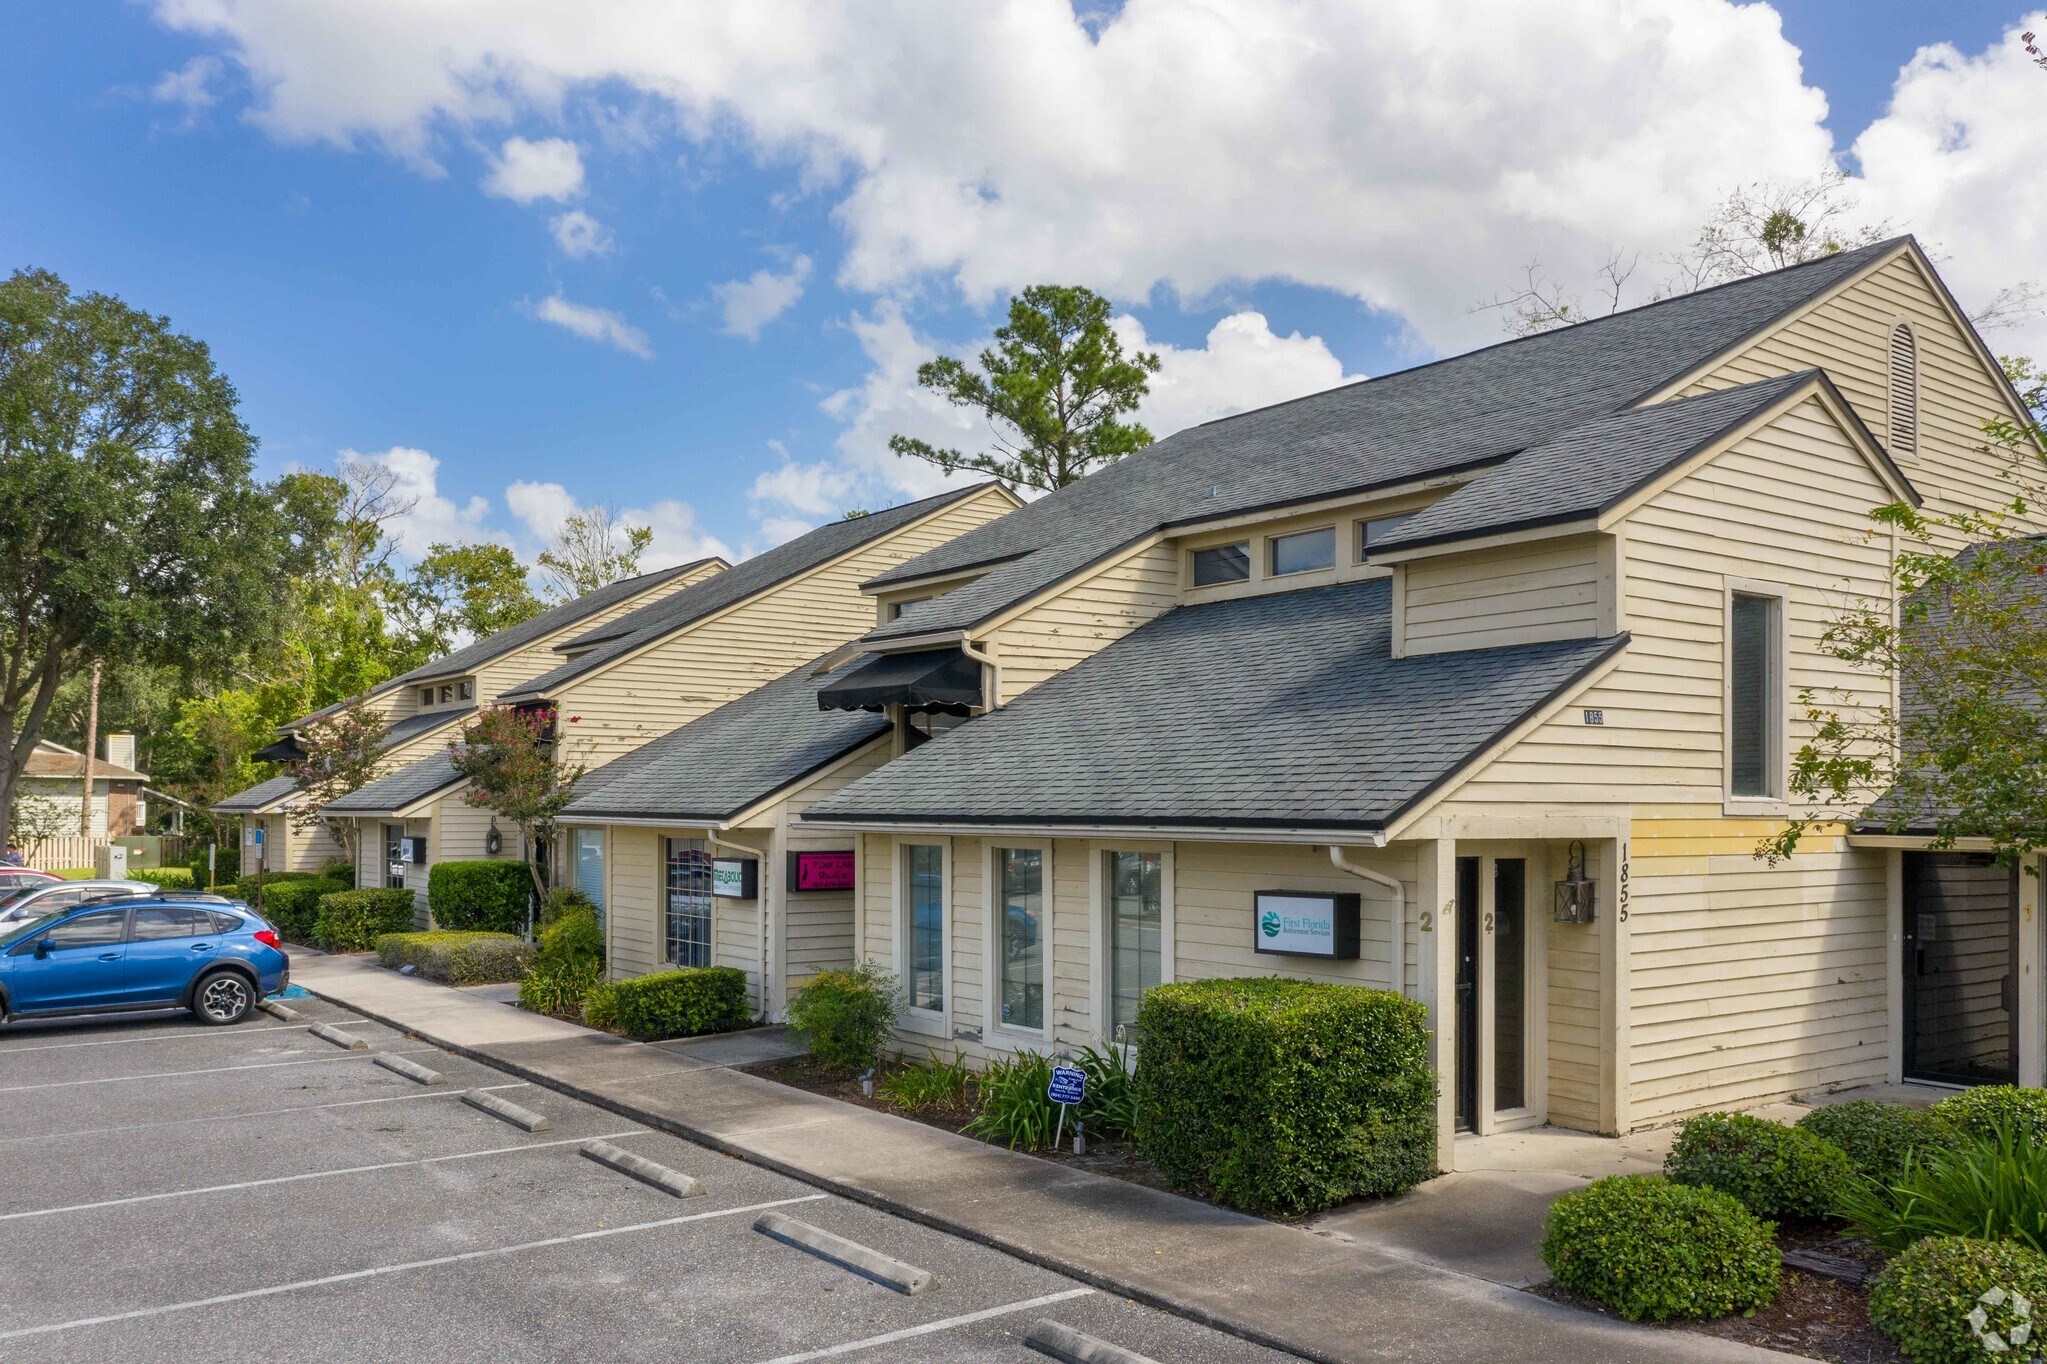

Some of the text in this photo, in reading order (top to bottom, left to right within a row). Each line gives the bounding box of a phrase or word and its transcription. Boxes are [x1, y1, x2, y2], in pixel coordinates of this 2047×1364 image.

[1585, 711, 1603, 724] 1855
[1620, 843, 1629, 923] 1855
[1283, 917, 1330, 930] First Florida
[1420, 911, 1433, 932] 2
[1484, 912, 1494, 932] 2
[1056, 1070, 1084, 1080] WARNING
